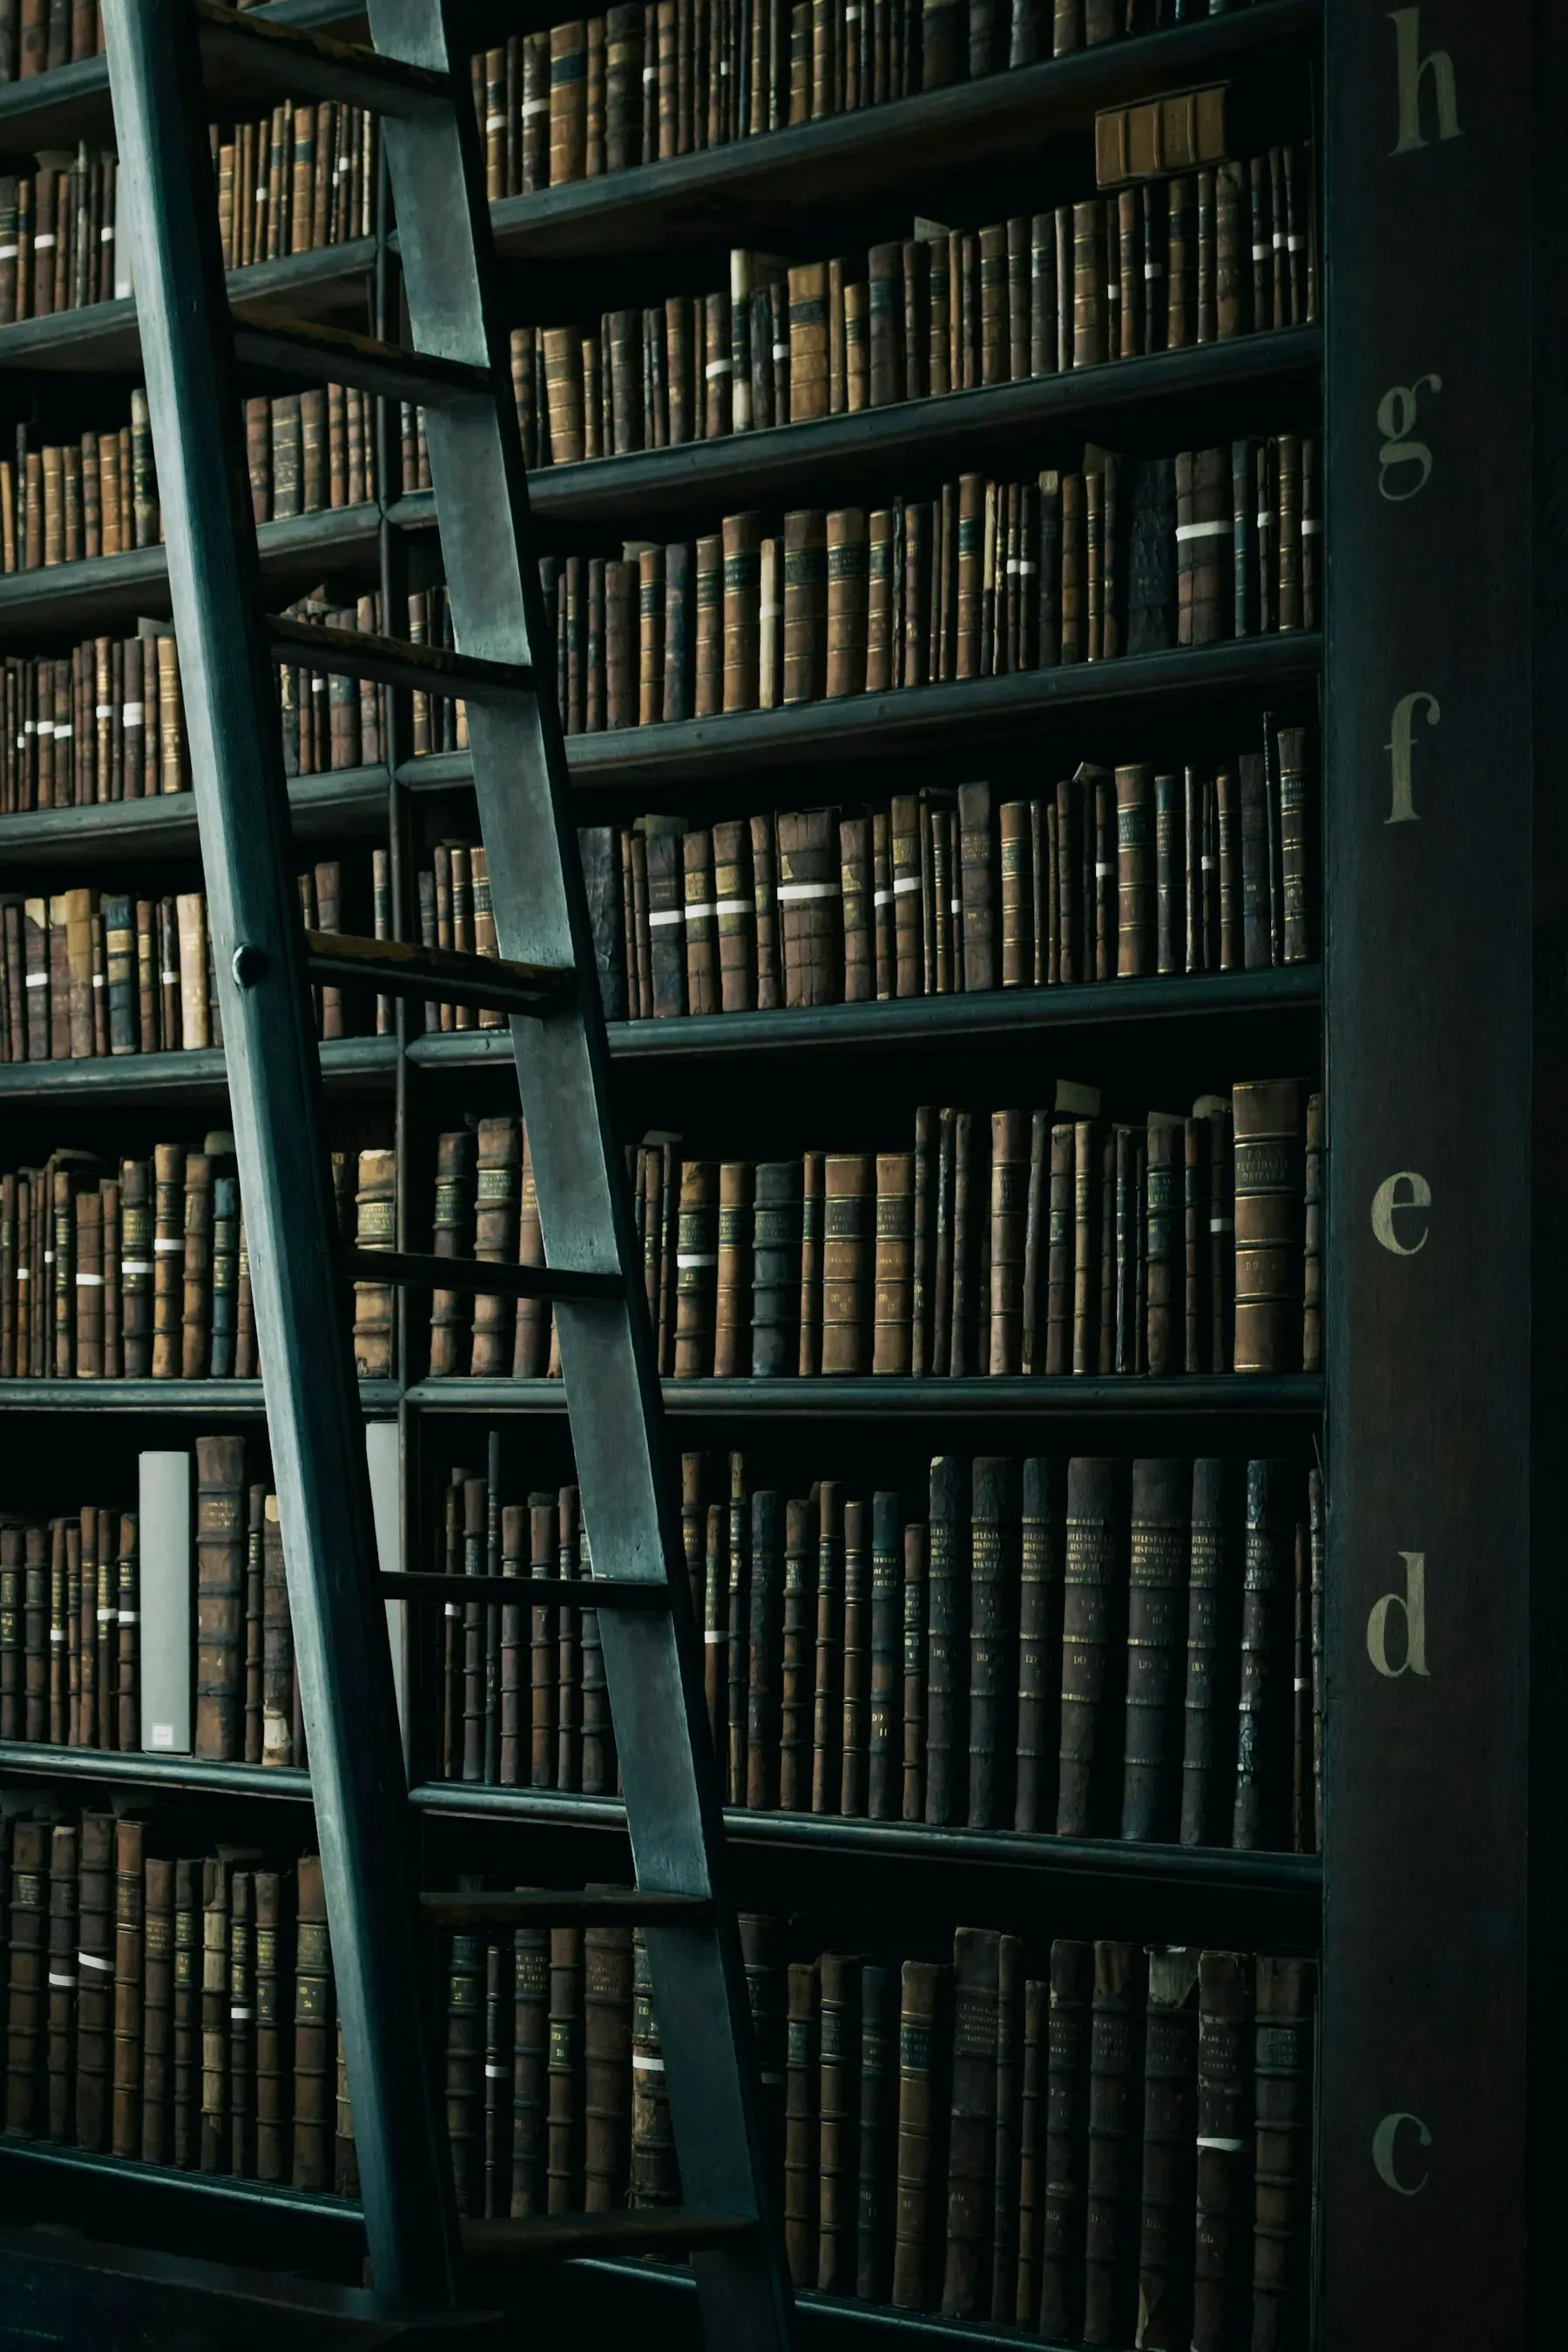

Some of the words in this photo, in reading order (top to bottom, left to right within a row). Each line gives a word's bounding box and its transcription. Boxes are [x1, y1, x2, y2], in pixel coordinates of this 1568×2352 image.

[1385, 7, 1464, 157] h
[1376, 373, 1442, 502] g
[1382, 692, 1441, 825] f
[1371, 1172, 1431, 1256] e
[1367, 1551, 1429, 1677] d
[1372, 2113, 1432, 2196] c
